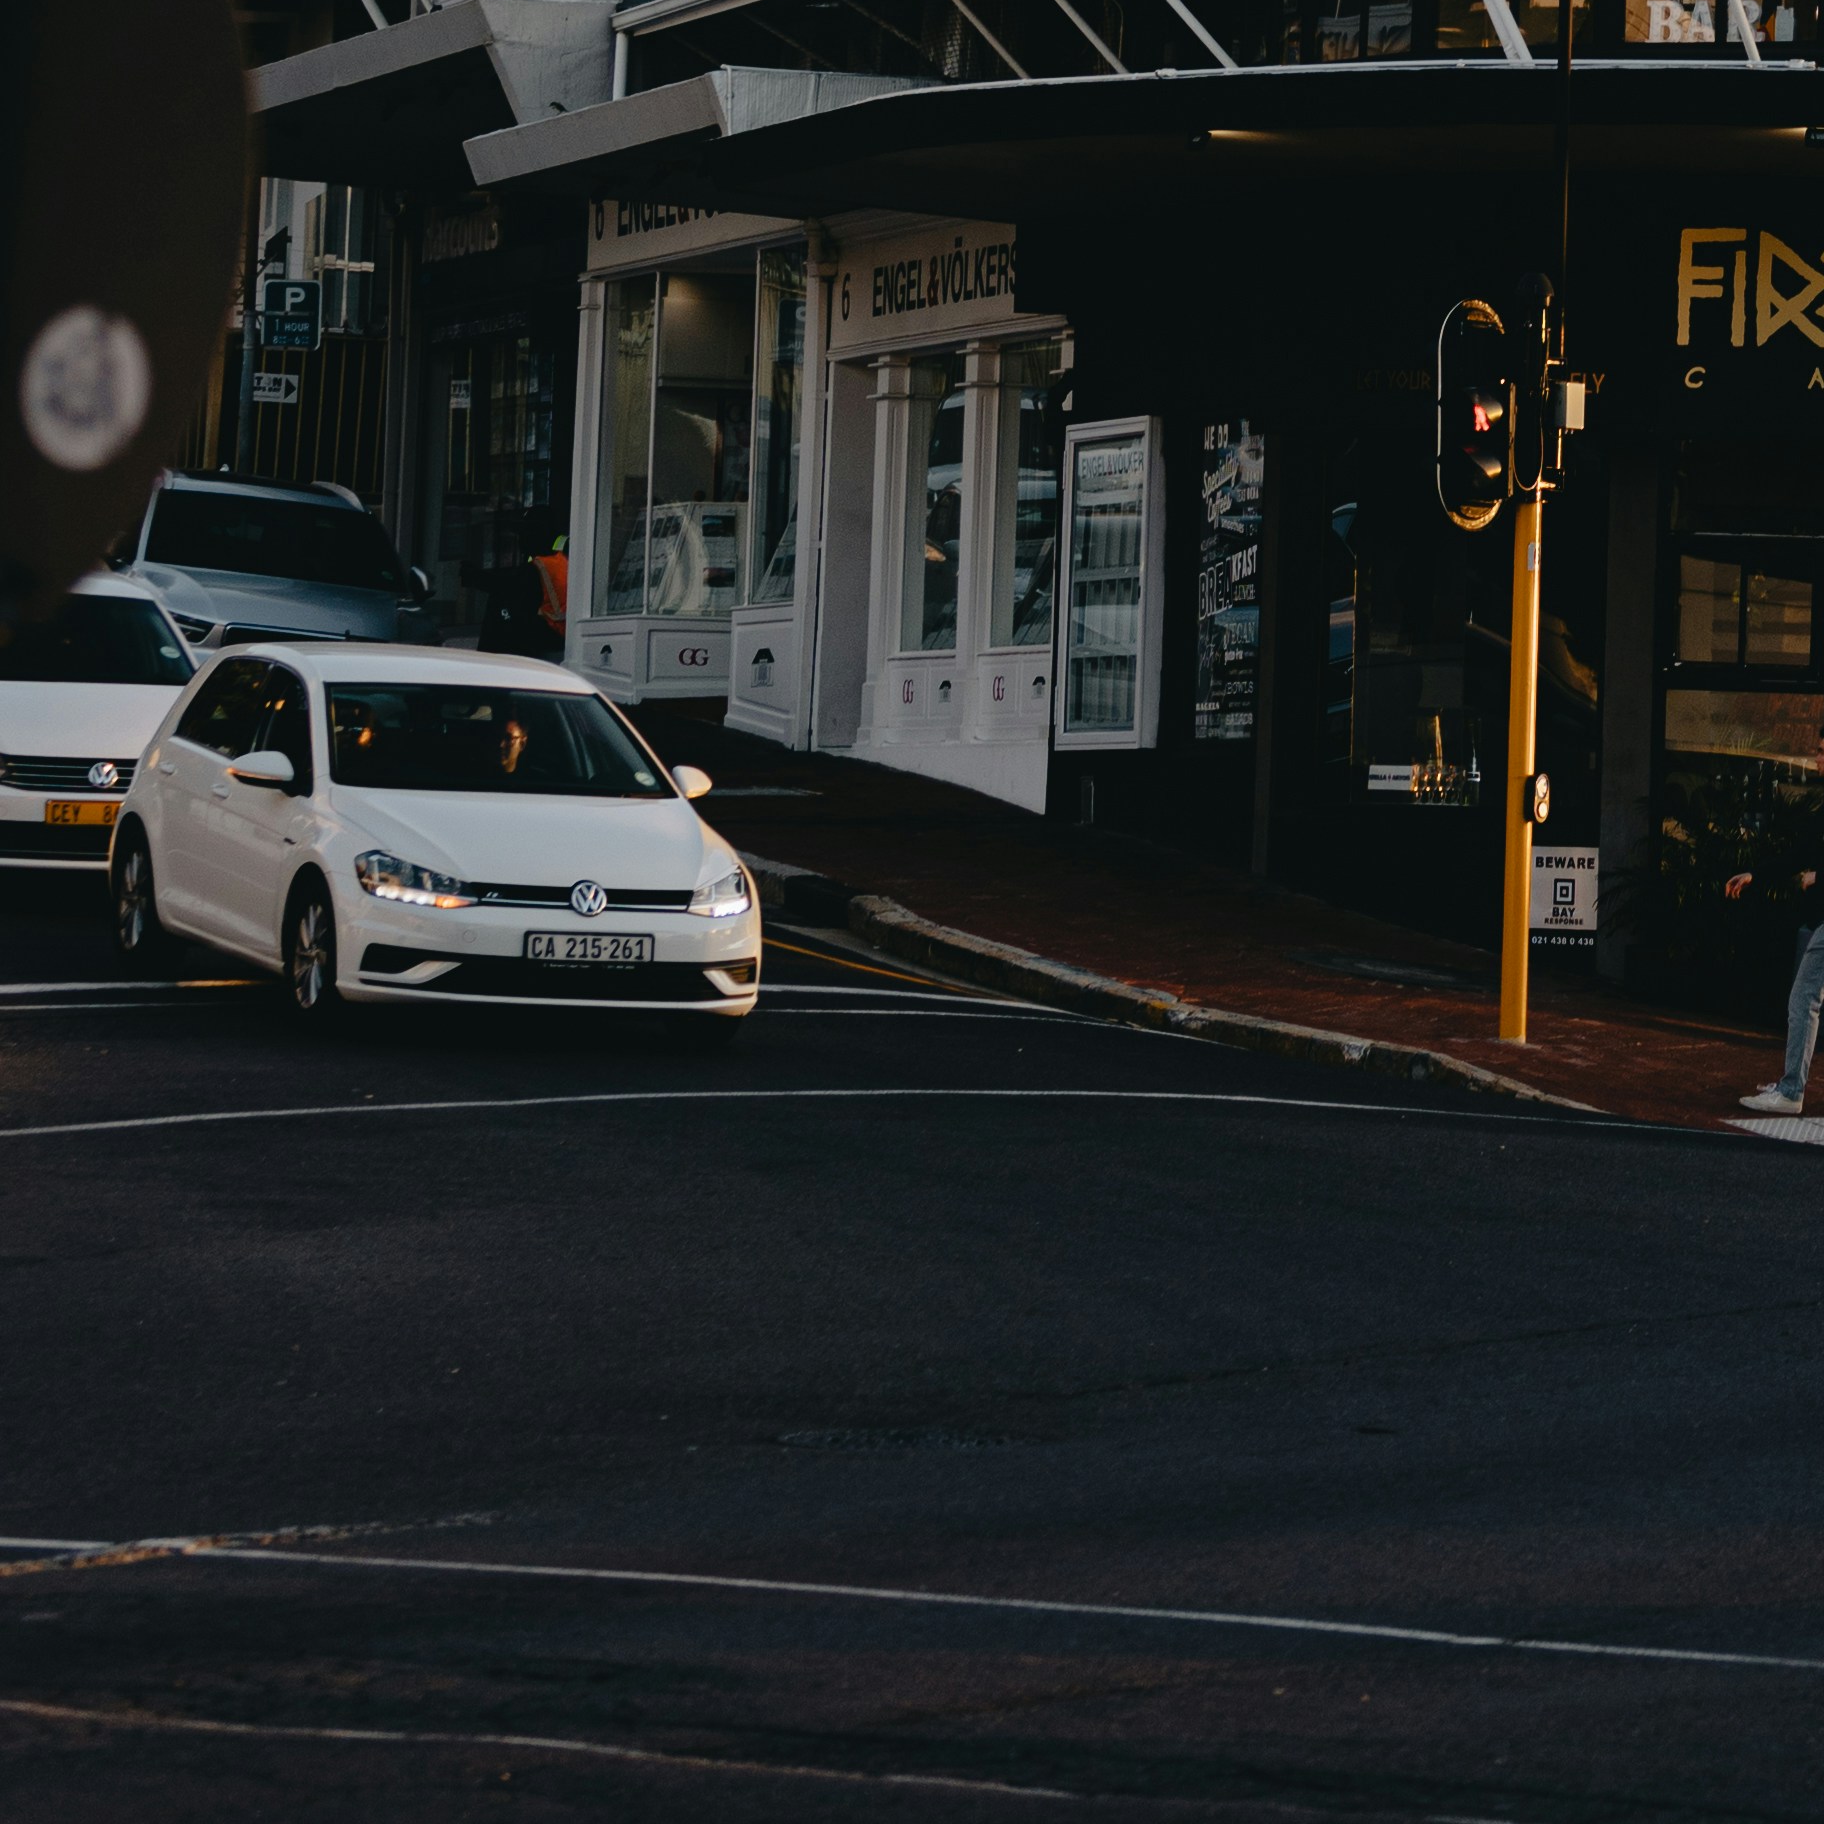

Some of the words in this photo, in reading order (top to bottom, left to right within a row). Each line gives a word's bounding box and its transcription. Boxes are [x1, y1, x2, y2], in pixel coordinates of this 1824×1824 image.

[1646, 0, 1766, 43] BAR
[285, 286, 306, 312] P
[842, 272, 851, 321] 6
[284, 322, 310, 333] HOUR
[1387, 369, 1432, 390] YOUR
[1535, 856, 1595, 870] BEWARE
[1544, 918, 1583, 926] RESPONSE
[1552, 907, 1576, 918] BAY
[531, 936, 556, 958] CA
[565, 937, 645, 961] 215-261
